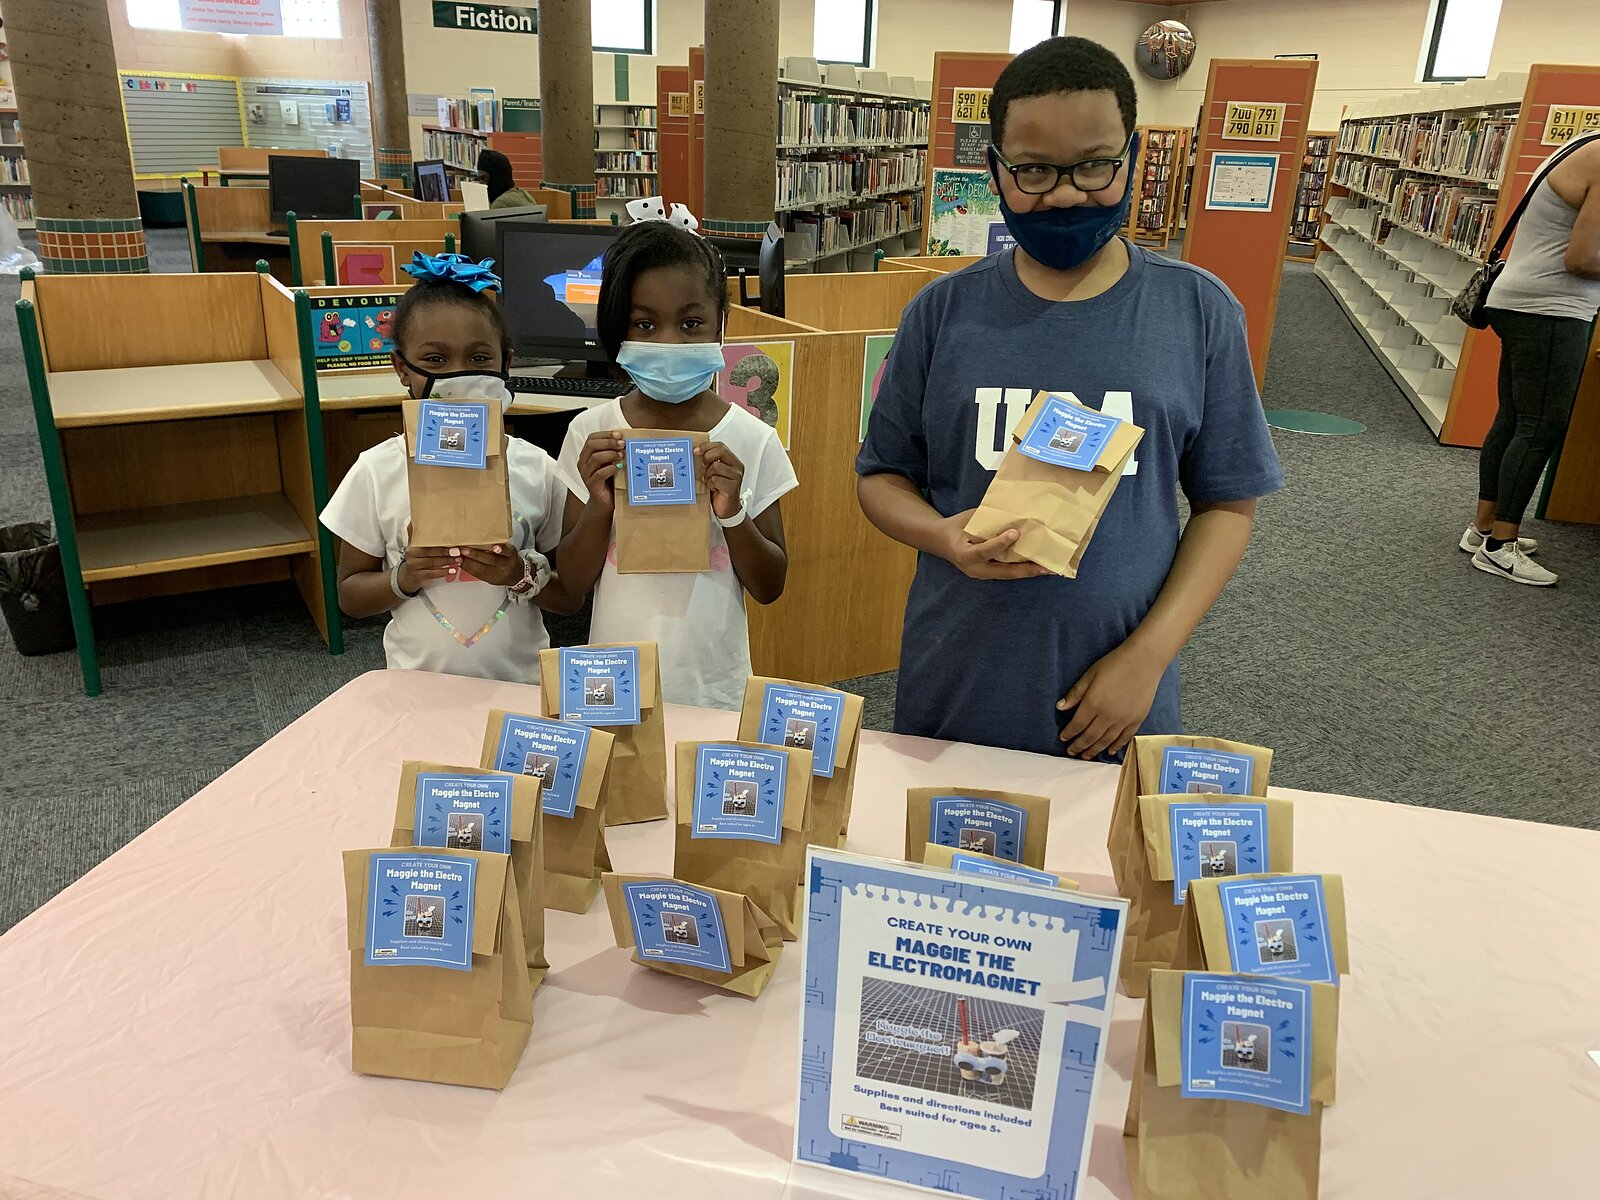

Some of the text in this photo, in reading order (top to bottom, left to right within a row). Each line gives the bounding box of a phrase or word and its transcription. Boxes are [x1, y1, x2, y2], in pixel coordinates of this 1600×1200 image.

[456, 5, 532, 31] Fiction
[958, 93, 976, 105] 590
[957, 107, 973, 119] 621
[1231, 107, 1277, 121] 700 791
[1553, 111, 1600, 126] 811 95
[1229, 122, 1275, 136] 790 811
[1551, 127, 1574, 140] 949
[936, 181, 967, 196] DEWEY
[318, 297, 397, 307] DEVOUR
[430, 410, 449, 418] Maggie
[1052, 408, 1074, 420] Maggie
[1085, 420, 1107, 429] Electro
[974, 387, 1140, 476] UA
[1065, 420, 1087, 431] Magnet
[570, 658, 592, 666] Maggie
[775, 696, 798, 706] Maggie
[811, 702, 832, 710] Electro
[792, 708, 815, 717] Magnet
[514, 728, 576, 745] Maggie the Electro
[532, 741, 557, 751] Magnet
[710, 758, 774, 771] Maggie the Electro
[1174, 760, 1198, 768] Maggie
[1213, 763, 1240, 774] Electro
[729, 769, 755, 778] Magnet
[1192, 770, 1219, 780] Magnet
[431, 788, 460, 798] Maggie
[474, 790, 499, 798] Electro
[453, 800, 480, 810] Magnet
[944, 809, 1013, 824] Maggie the Electro
[1182, 818, 1253, 827] Maggie the Electro
[964, 818, 992, 828] Magnet
[1202, 829, 1231, 837] Magnet
[387, 869, 462, 881] Maggie the Electro
[411, 881, 442, 892] Magnet
[682, 895, 707, 907] Electro
[1234, 892, 1309, 906] Maggie the Electro
[663, 902, 689, 911] Magnet
[1255, 906, 1286, 916] Magnet
[887, 917, 1032, 952] CREATE YOUR OWN
[896, 936, 1016, 973] MAGGIE THE
[868, 951, 1041, 996] ELECTROMAGNET
[1201, 991, 1293, 1009] Maggie the Electro
[1227, 1006, 1264, 1018] Magnet
[853, 1084, 1032, 1127] Supplies and directions included
[879, 1102, 1001, 1134] Best suited for ages 5+
